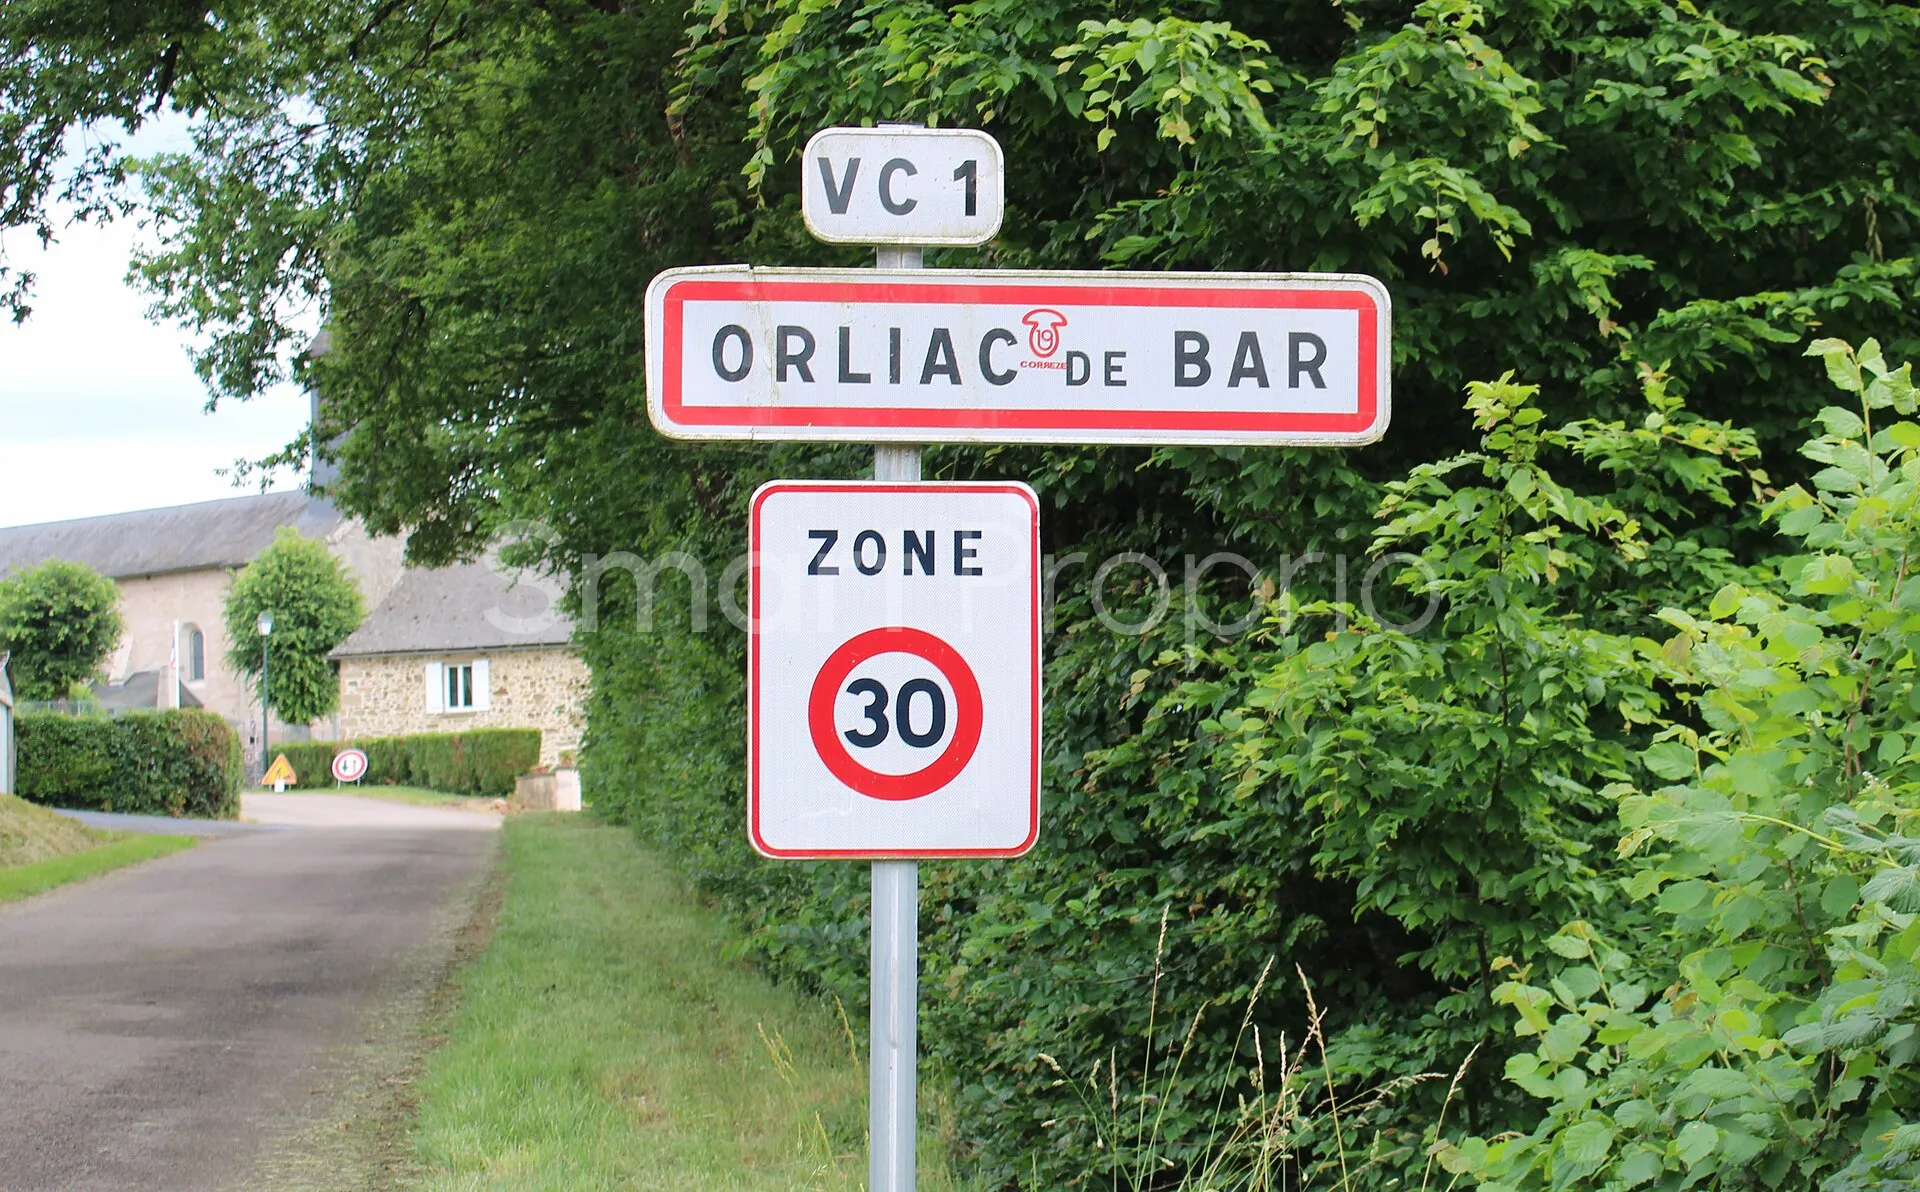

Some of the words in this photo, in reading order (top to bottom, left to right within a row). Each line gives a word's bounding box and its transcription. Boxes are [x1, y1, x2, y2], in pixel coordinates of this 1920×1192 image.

[817, 157, 918, 216] VC
[953, 160, 977, 216] 1
[711, 324, 1018, 386] ORLIAC
[1065, 350, 1128, 387] DE
[1174, 330, 1327, 389] BAR
[1019, 360, 1068, 370] CORREZE
[807, 528, 984, 577] ZONE
[844, 677, 947, 749] 30
